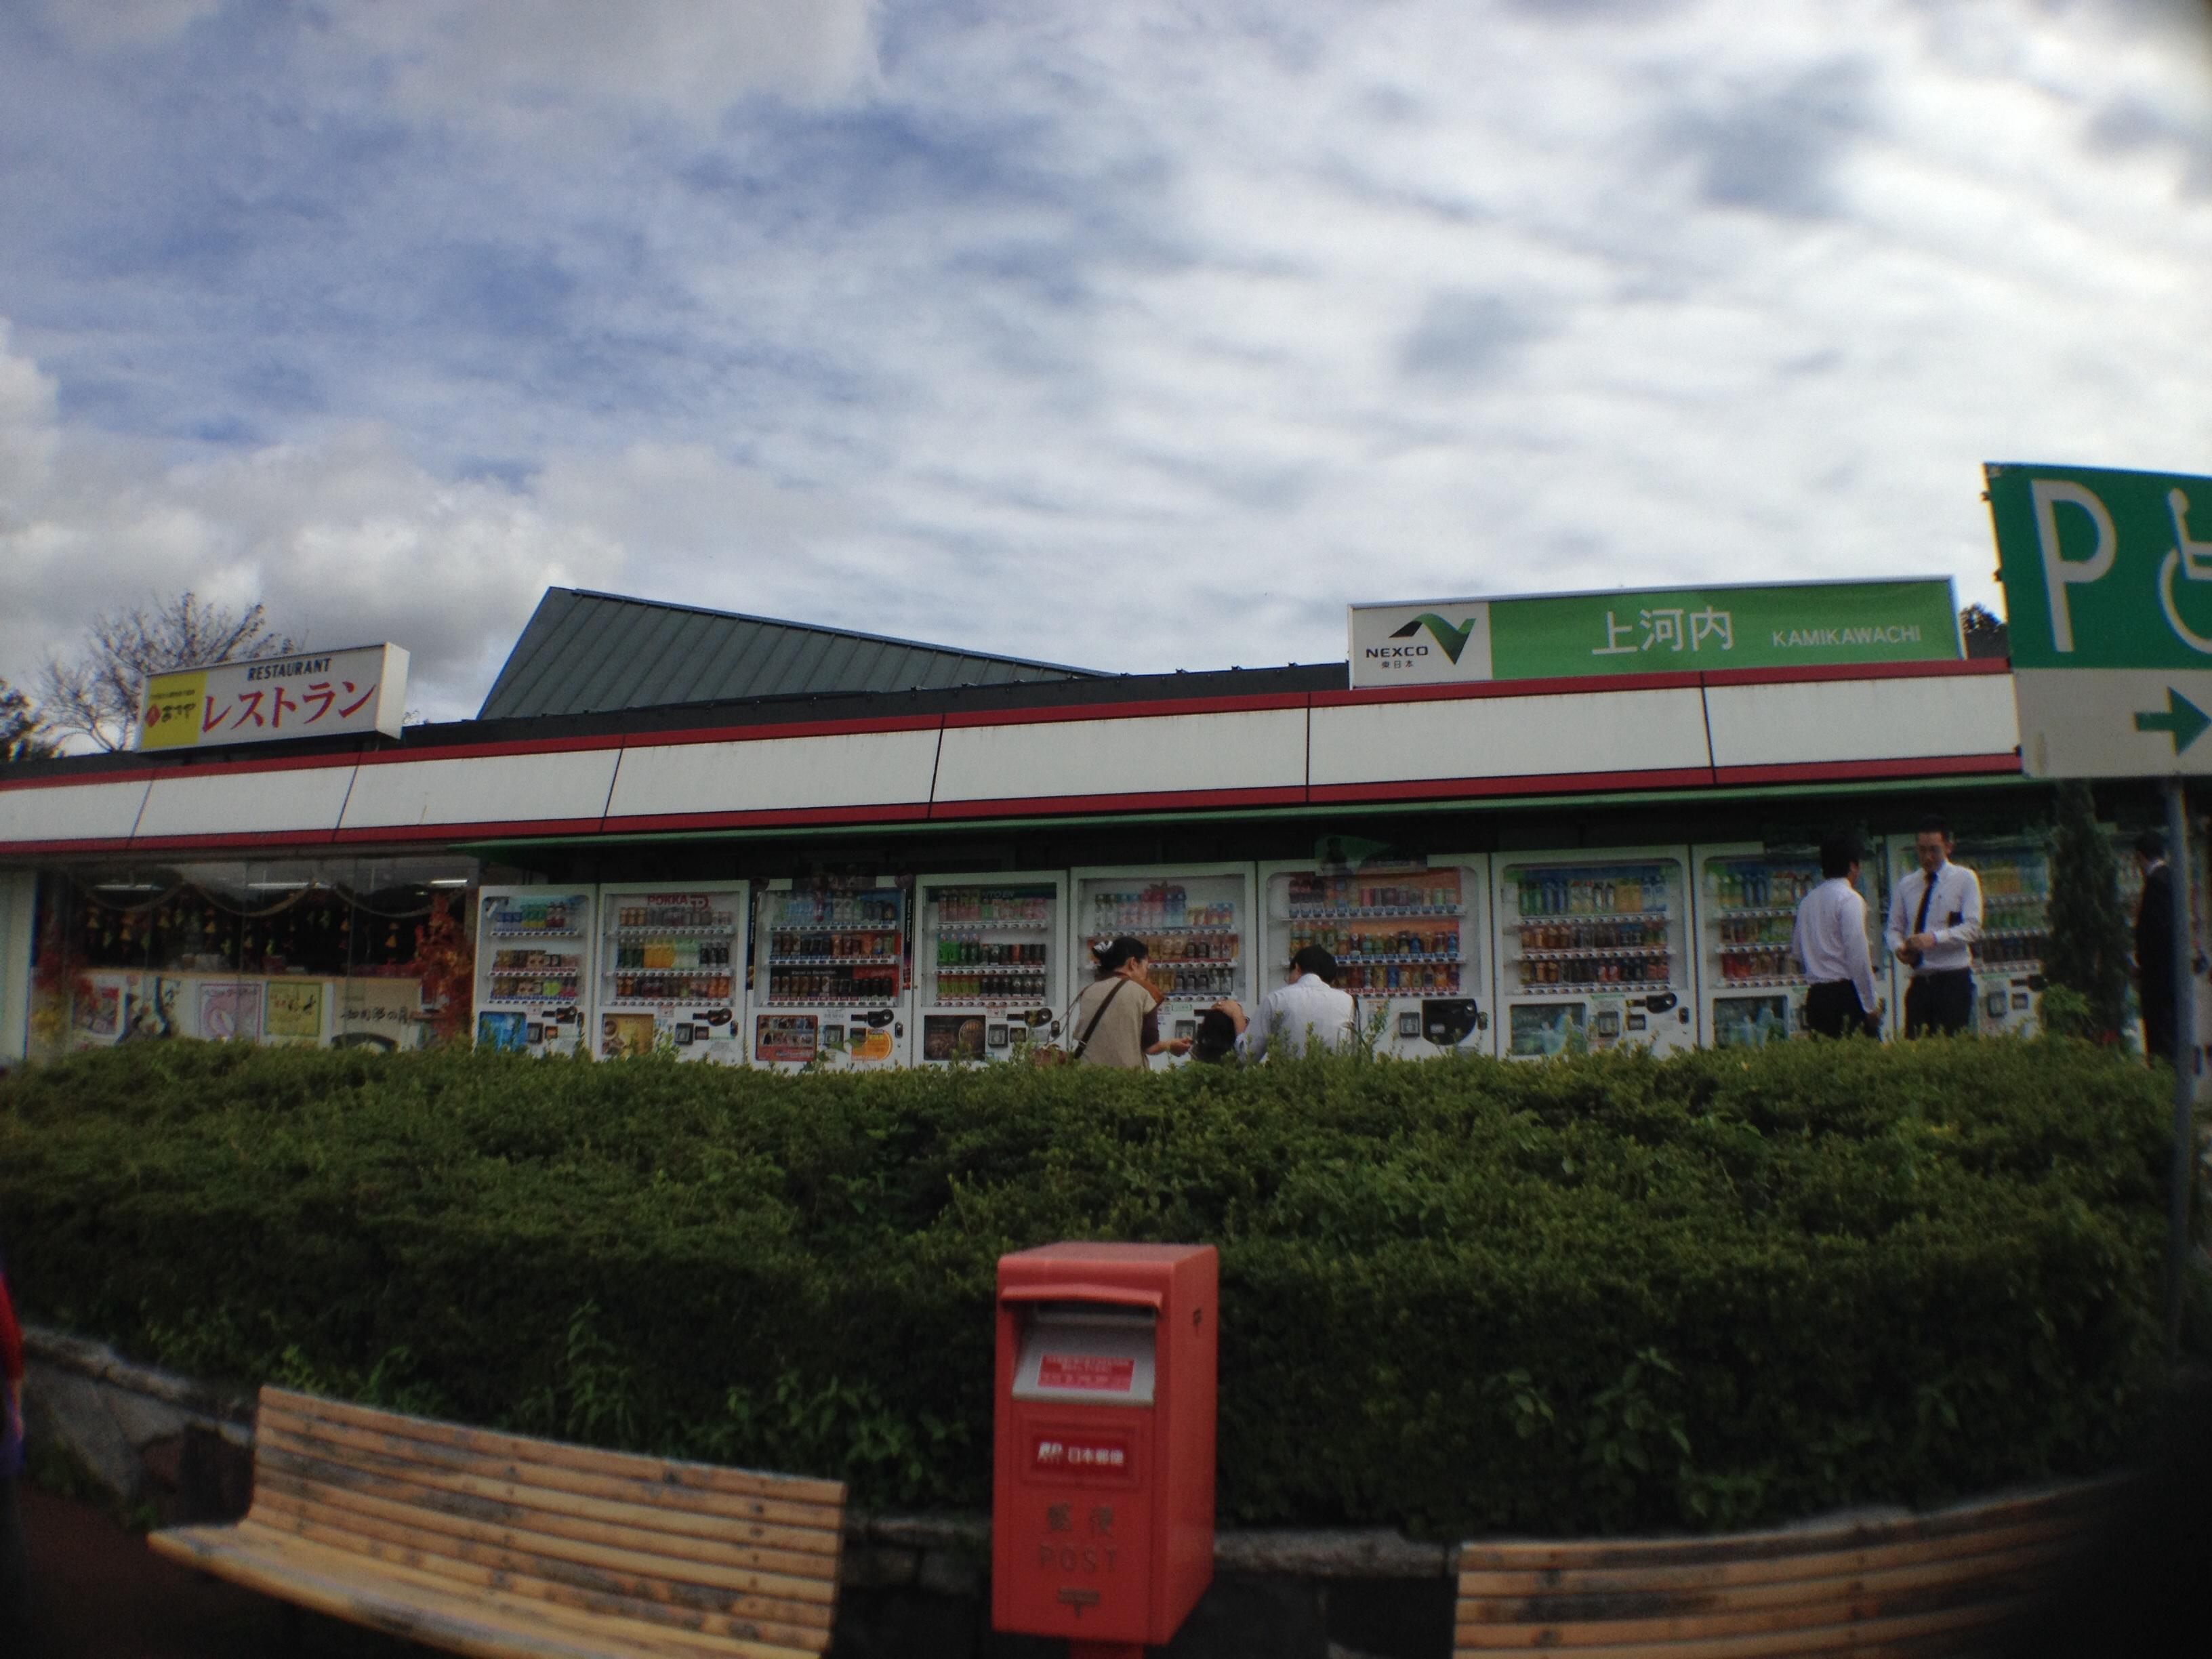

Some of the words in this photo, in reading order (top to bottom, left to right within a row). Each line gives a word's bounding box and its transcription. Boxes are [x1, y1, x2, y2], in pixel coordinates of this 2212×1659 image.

[2031, 479, 2118, 653] P
[1591, 606, 1733, 657] 上河内
[1771, 623, 1921, 649] KAMIKAWACHI
[1366, 646, 1429, 659] NEXCO
[1381, 659, 1414, 670] 東日本
[248, 658, 331, 680] RESTAURANT
[201, 680, 377, 733] レストラン
[647, 893, 688, 905] POKKA
[1039, 1543, 1118, 1573] POST
